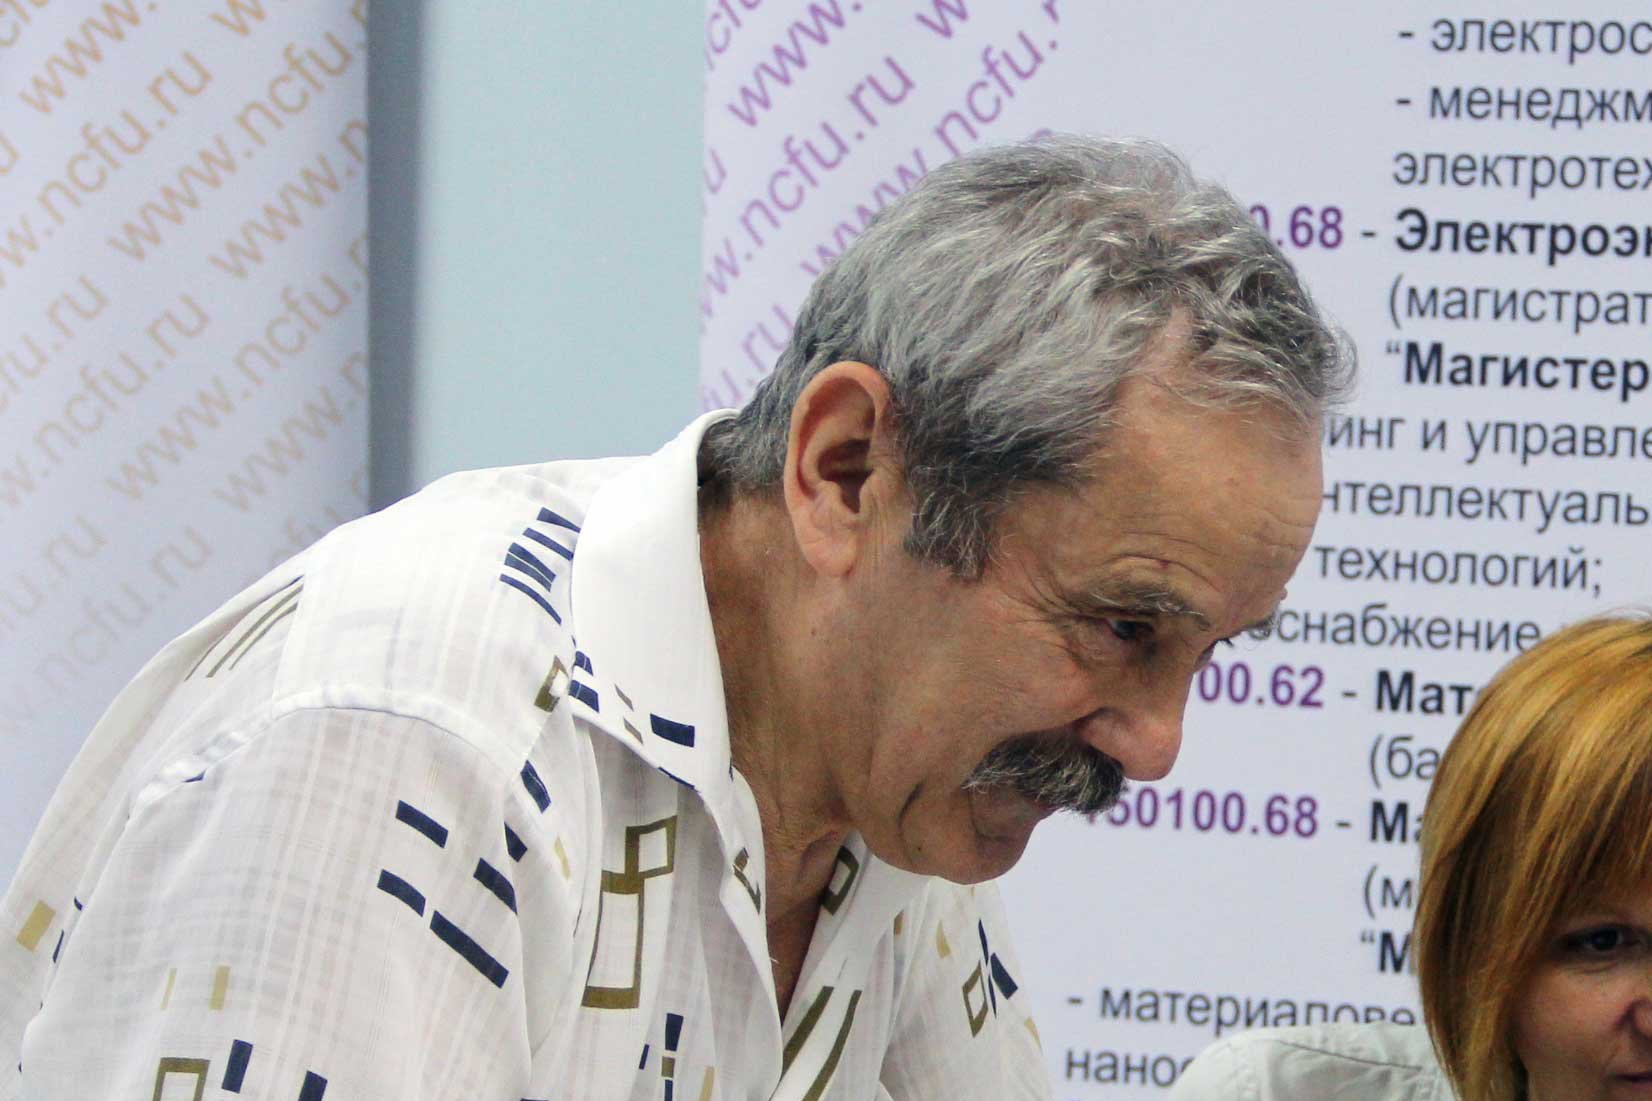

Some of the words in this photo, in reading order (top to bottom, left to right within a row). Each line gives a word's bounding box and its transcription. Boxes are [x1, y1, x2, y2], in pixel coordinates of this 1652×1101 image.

[0, 50, 214, 288] w.ncfu.ru
[702, 55, 916, 318] w.ncfu.ru
[1328, 416, 1406, 450] инг
[1421, 419, 1447, 452] и
[1313, 545, 1602, 598] технологий;
[1376, 669, 1479, 716] Мат
[1087, 786, 1319, 839] 50100.68
